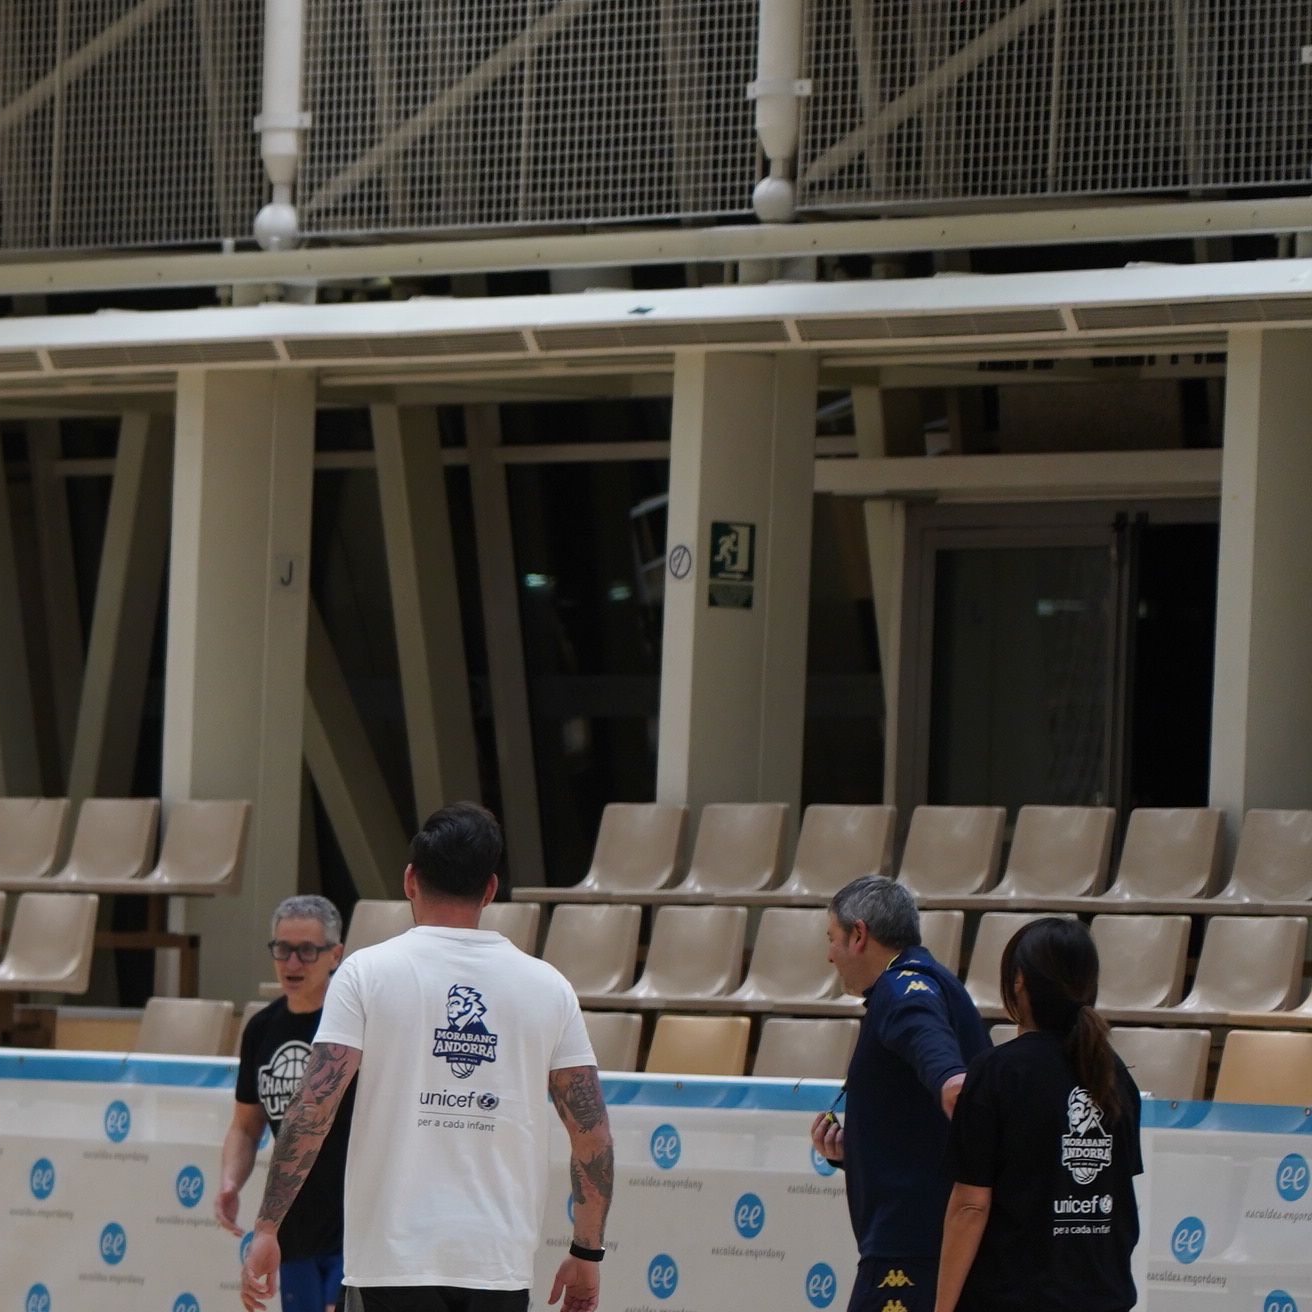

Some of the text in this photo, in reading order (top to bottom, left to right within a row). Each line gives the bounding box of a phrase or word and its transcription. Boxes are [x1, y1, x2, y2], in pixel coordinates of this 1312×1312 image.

[436, 1030, 497, 1044] MORABANC
[434, 1040, 495, 1060] ANDORRA
[420, 1089, 476, 1108] unicef
[418, 1118, 496, 1132] per a cada infant
[1063, 1147, 1111, 1160] ANDORRA
[1054, 1195, 1099, 1214] unicef
[1070, 1224, 1092, 1234] cada
